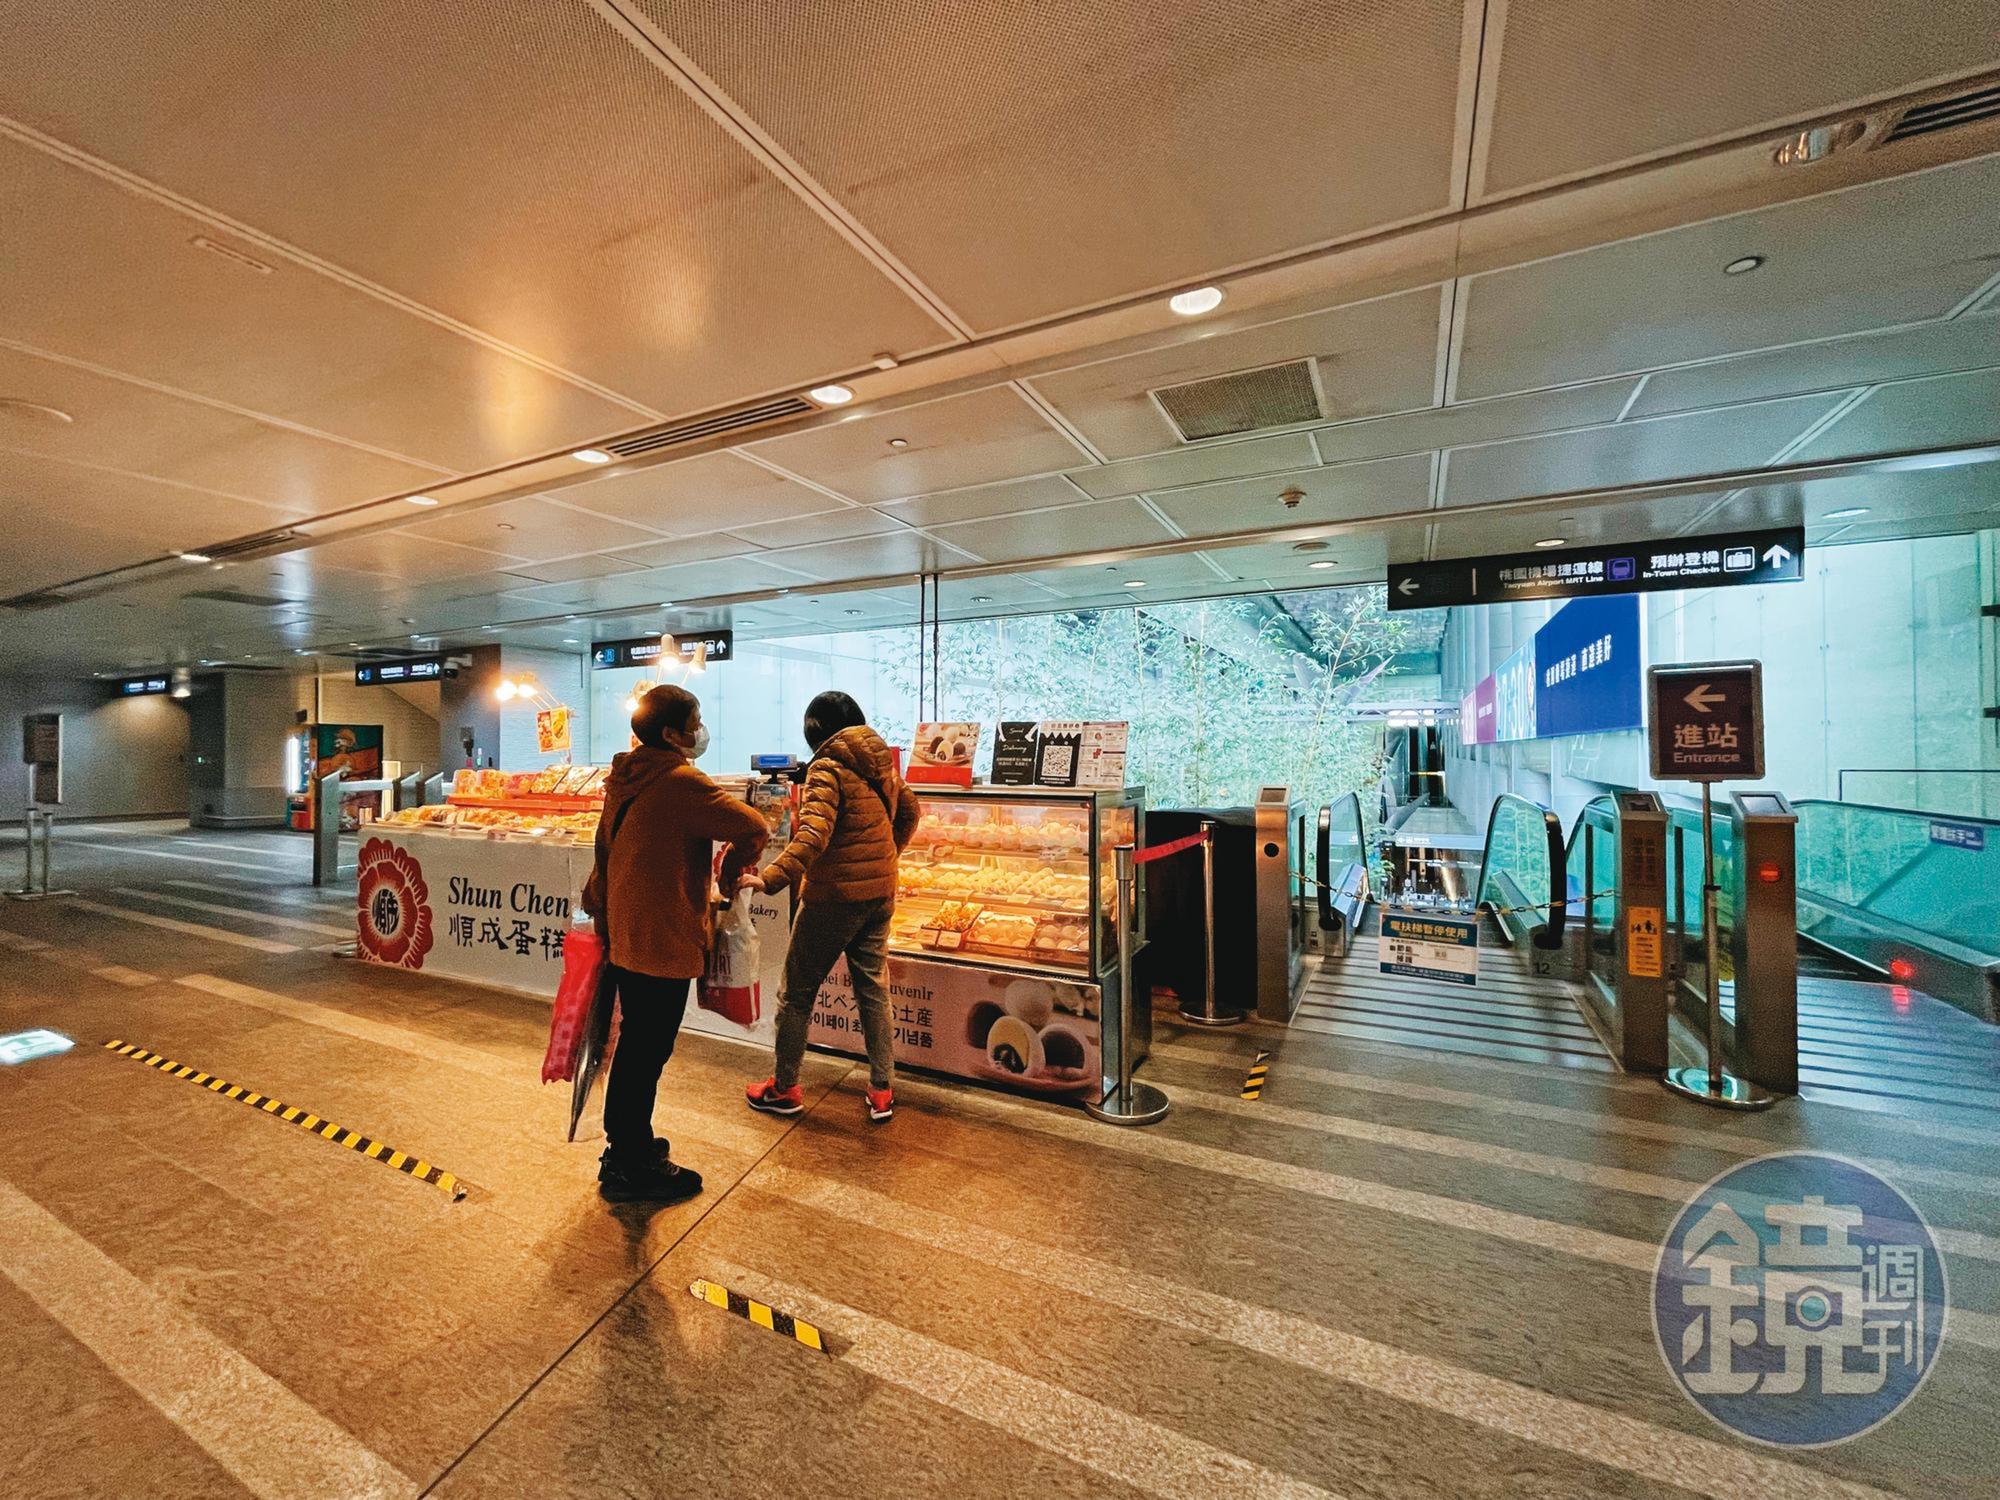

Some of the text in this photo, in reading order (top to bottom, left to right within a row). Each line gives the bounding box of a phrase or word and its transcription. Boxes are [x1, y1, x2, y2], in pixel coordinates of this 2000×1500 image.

[1650, 550, 1719, 569] 預辦登機
[1643, 570, 1678, 578] In-Town
[1674, 722, 1738, 749] 進站
[1673, 752, 1741, 763] Entrance
[448, 876, 570, 918] Shun Chen
[448, 913, 567, 961] 順成蛋糕
[1534, 962, 1551, 975] 12
